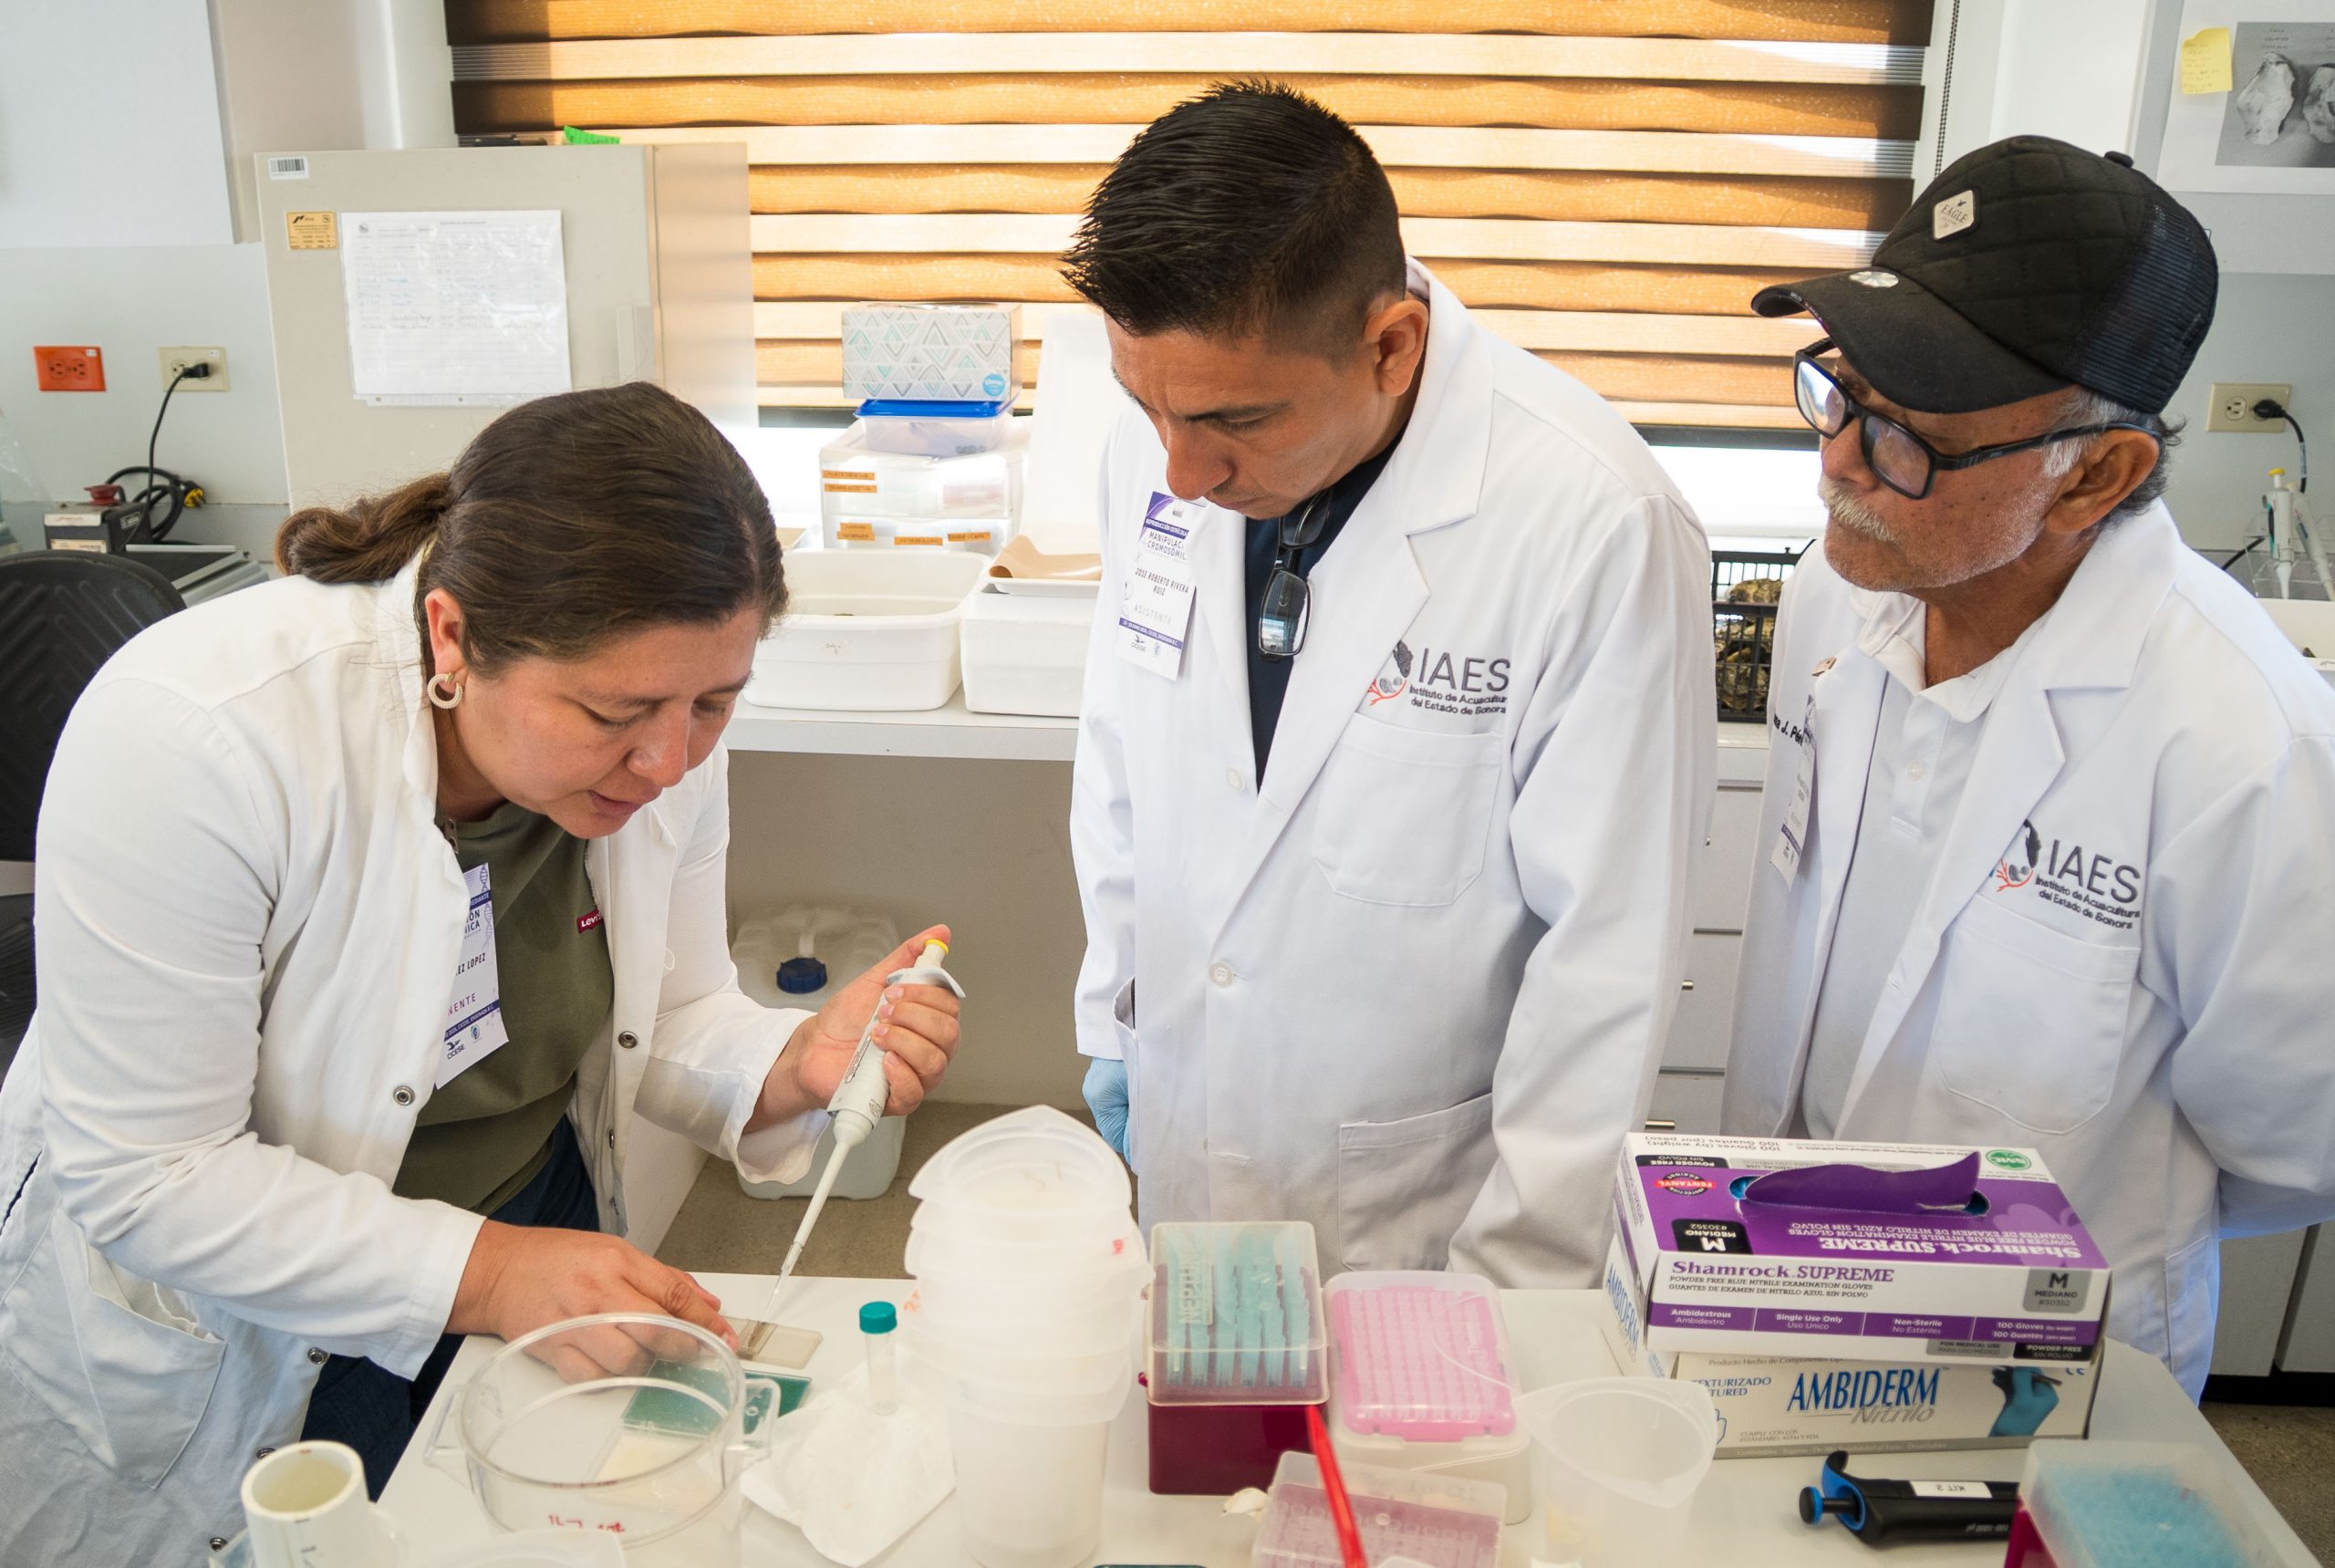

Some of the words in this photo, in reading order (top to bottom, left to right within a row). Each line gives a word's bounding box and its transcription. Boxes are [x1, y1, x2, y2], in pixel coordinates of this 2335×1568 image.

[1941, 203, 1969, 223] EAGLE
[1147, 572, 1170, 588] ROBERTO
[1170, 579, 1189, 595] RIVERA
[1153, 586, 1166, 597] RUIZ
[1134, 604, 1172, 626] ASISTENTE
[1418, 648, 1511, 692] IAES
[1409, 684, 1443, 701] Instituto
[1445, 693, 1458, 702] de
[1459, 695, 1508, 705] Acuacultur
[1411, 698, 1423, 708] del
[1425, 699, 1458, 714] Estado
[1460, 706, 1473, 715] de
[1475, 704, 1507, 715] Sonora
[2048, 839, 2141, 904] IAES
[2036, 874, 2070, 896] Instituto
[2071, 889, 2082, 901] de
[2082, 894, 2141, 919] Acuacultura
[2039, 889, 2052, 902] del
[2053, 895, 2081, 913] Estado
[2082, 907, 2094, 919] de
[2094, 912, 2133, 929] Sonora
[467, 953, 486, 971] LOPEZ
[1790, 1222, 1831, 1231] POLVO
[1832, 1223, 1852, 1232] SIN
[1854, 1224, 1884, 1234] AZUL
[1887, 1226, 1931, 1236] NITRILO
[1685, 1230, 1737, 1238] MEDIANO
[1788, 1229, 1835, 1239] GLOVES
[1836, 1231, 1919, 1241] EXAMINATION
[1933, 1228, 1950, 1237] DE
[1951, 1229, 2000, 1239] EXAMEN
[2002, 1231, 2018, 1240] DE
[2019, 1231, 2073, 1241] GUANTES
[1921, 1233, 1964, 1243] NITRILE
[1966, 1235, 1997, 1244] BLUE
[1998, 1236, 2025, 1245] FREE
[2027, 1236, 2077, 1246] POWDER
[1700, 1237, 1727, 1251] M
[1820, 1237, 1936, 1254] SUPREME
[1949, 1241, 2082, 1259] Shamrock
[1672, 1261, 1789, 1278] Shamrock
[1797, 1265, 1894, 1282] SUPREME
[1749, 1279, 1780, 1287] NITRILE
[1782, 1280, 1841, 1289] EXAMINATION
[1842, 1282, 1873, 1291] GLOVES
[2049, 1272, 2070, 1289] M
[1720, 1285, 1755, 1293] EXAMEN
[1769, 1287, 1802, 1296] NITRILO
[1803, 1289, 1825, 1297] AZUL
[1842, 1291, 1869, 1299] POLVO
[2035, 1290, 2078, 1299] MEDIANO
[1671, 1308, 1732, 1319] Ambidextrous
[1676, 1317, 1726, 1326] Ambidextro
[1776, 1313, 1803, 1324] Single
[1804, 1314, 1822, 1323] Use
[1822, 1314, 1843, 1325] Only
[1894, 1318, 1943, 1327] Non-Sterile
[1787, 1322, 1805, 1330] Uso
[1892, 1325, 1906, 1334] No
[1997, 1322, 2014, 1330] 100
[2015, 1323, 2044, 1331] Gloves
[1993, 1331, 2008, 1339] 100
[2010, 1331, 2043, 1340] Guantes
[2027, 1344, 2061, 1352] POWDER
[1708, 1358, 1741, 1366] Producto
[1743, 1357, 1767, 1366] Hecho
[1768, 1356, 1778, 1365] de
[1707, 1387, 1748, 1397] TURED
[1787, 1367, 1942, 1411] AMBIDERM
[1852, 1403, 1935, 1424] Nitrilo
[1948, 1484, 1967, 1492] KIT
